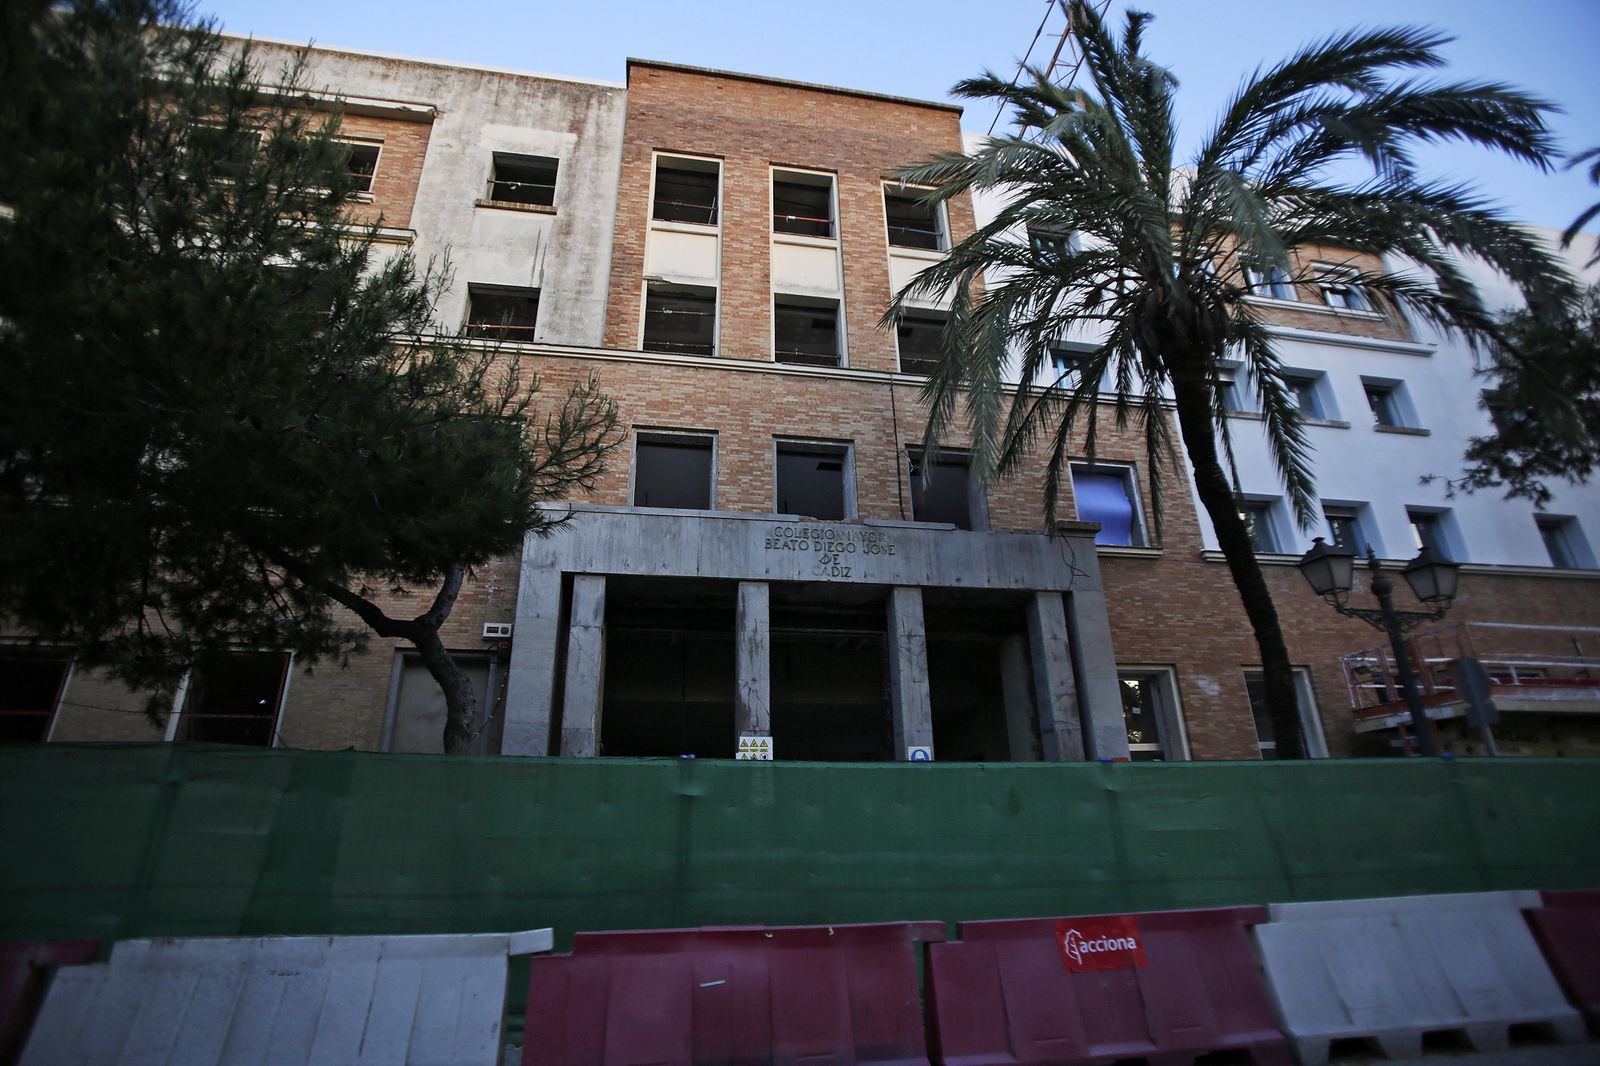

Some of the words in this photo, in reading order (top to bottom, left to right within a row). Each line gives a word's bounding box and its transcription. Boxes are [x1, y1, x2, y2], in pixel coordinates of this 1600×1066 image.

[774, 526, 835, 540] COLEGIO
[764, 538, 809, 551] BEATO
[813, 541, 856, 554] DIEGO
[819, 553, 841, 565] DE
[1079, 935, 1137, 953] acciona
